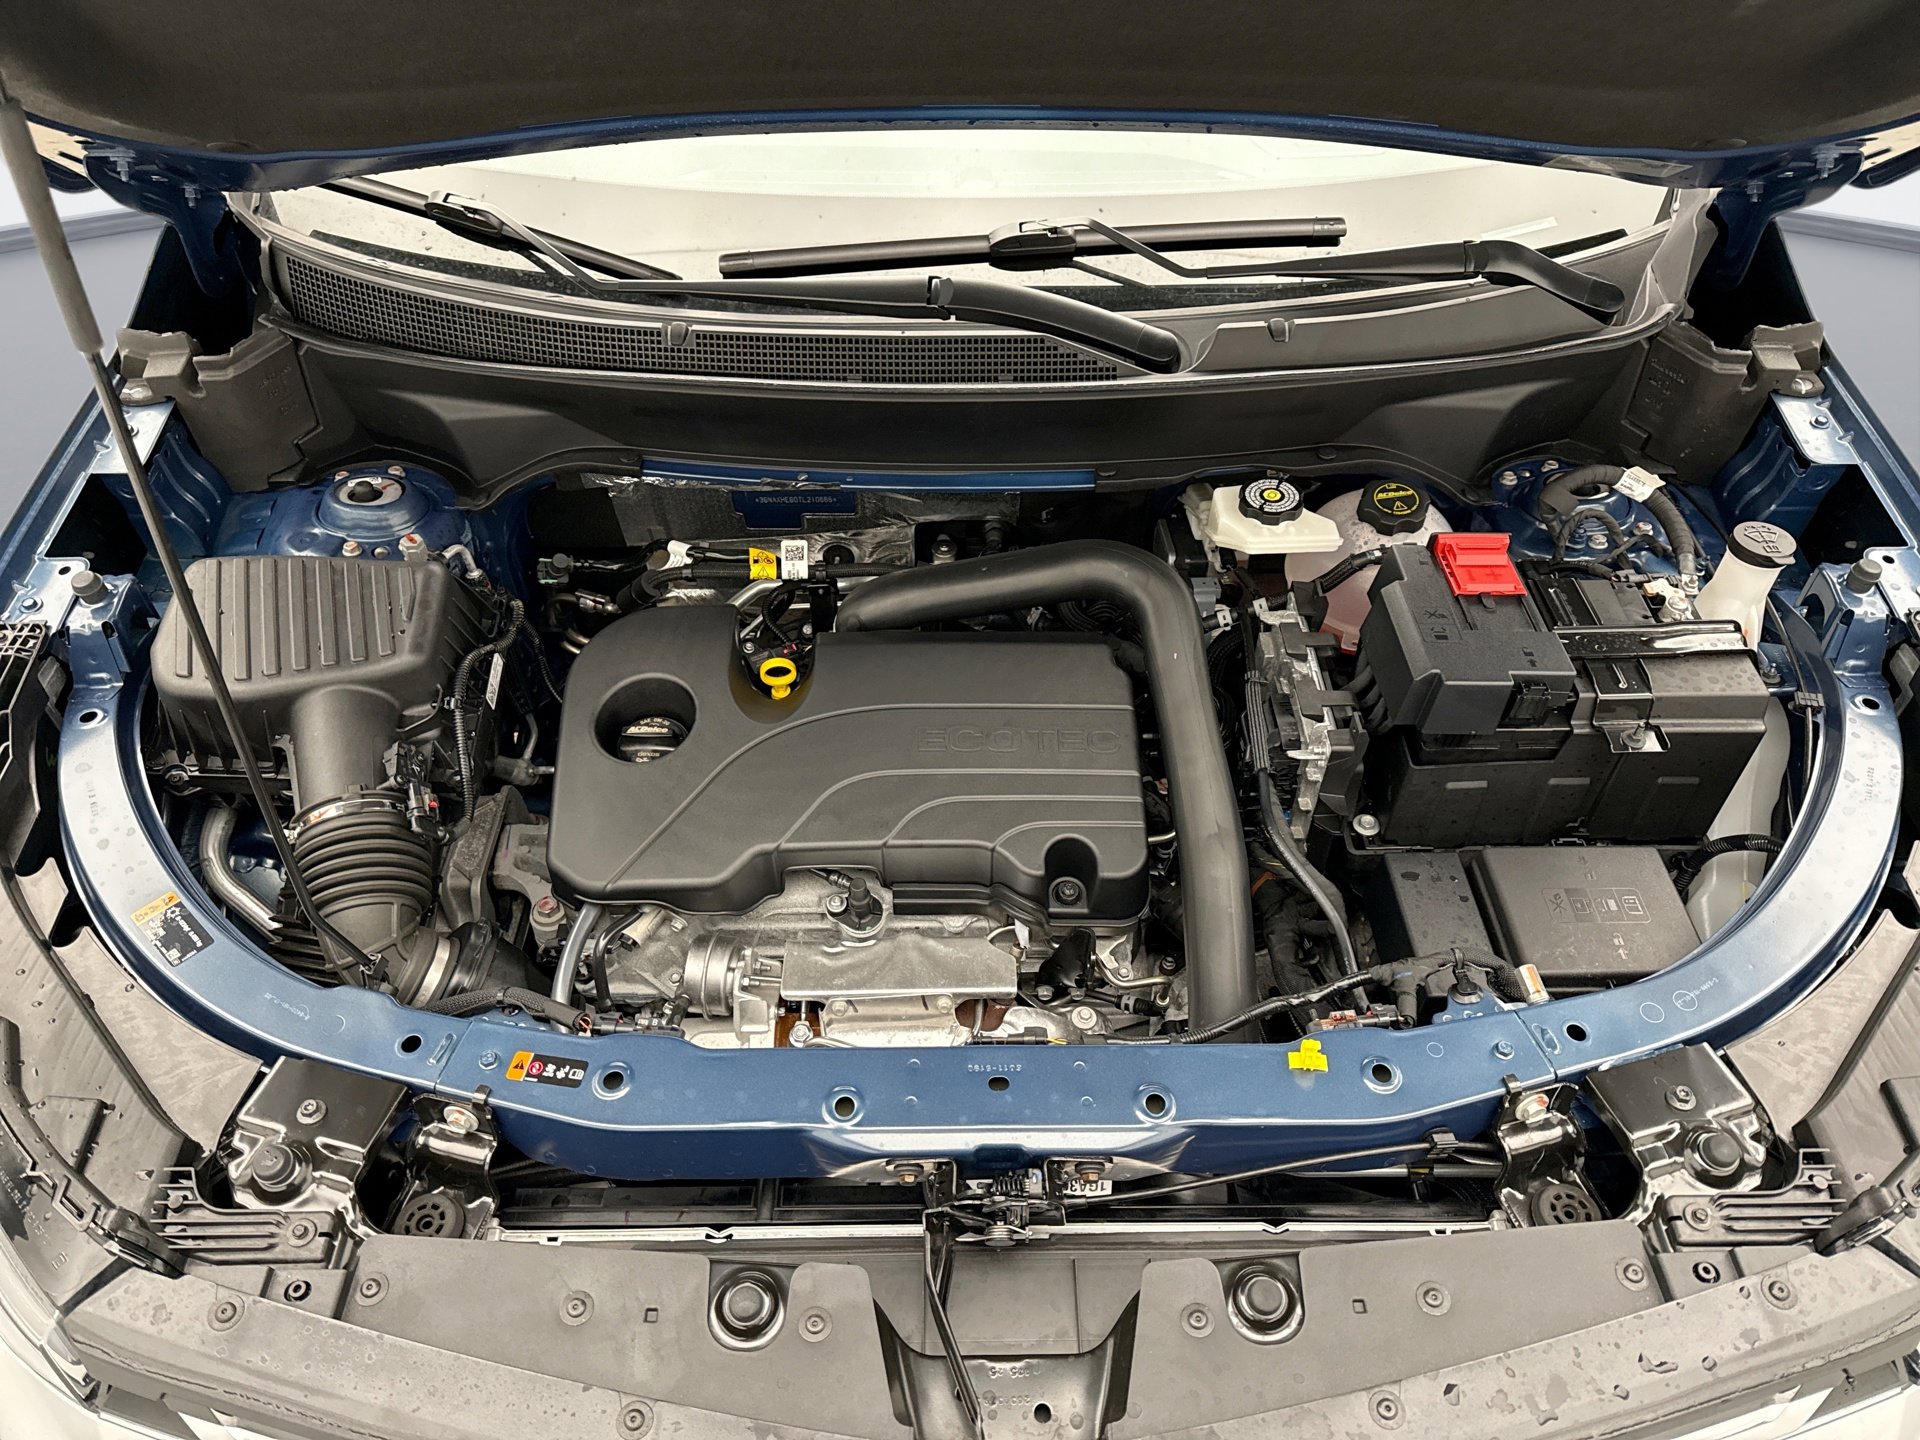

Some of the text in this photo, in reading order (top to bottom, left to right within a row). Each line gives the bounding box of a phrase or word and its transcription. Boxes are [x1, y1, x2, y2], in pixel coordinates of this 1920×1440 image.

[1376, 490, 1413, 499] ACDelco
[626, 725, 669, 733] ACDelco
[916, 727, 1122, 753] ECOTEC
[1066, 1180, 1107, 1193] 1GA3
